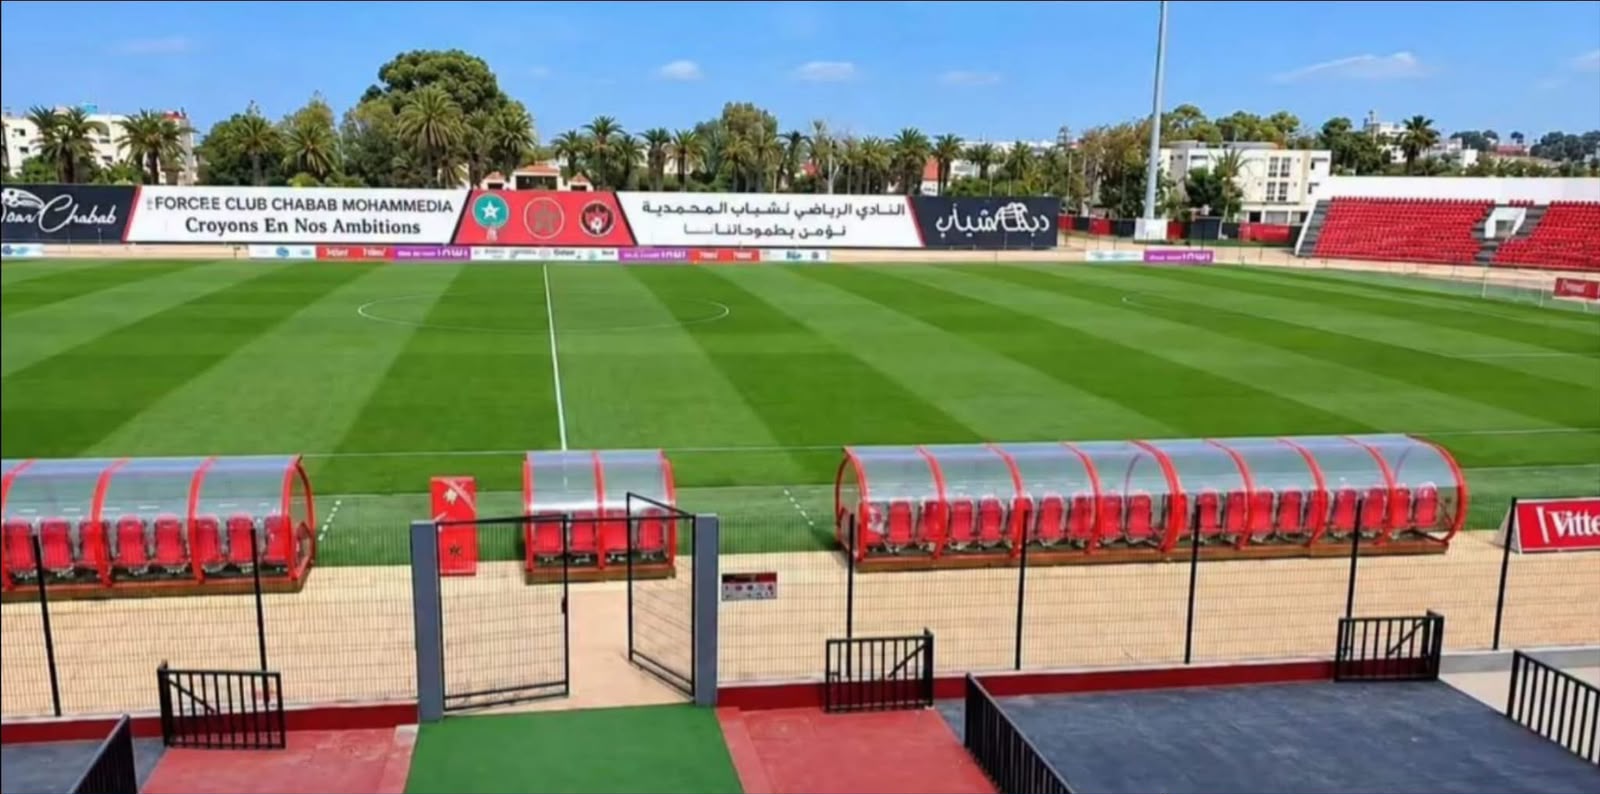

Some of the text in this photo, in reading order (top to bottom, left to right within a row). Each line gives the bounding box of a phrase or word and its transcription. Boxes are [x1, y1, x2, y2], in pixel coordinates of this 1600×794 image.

[38, 194, 117, 233] Chabab
[225, 197, 267, 211] CLUB
[271, 198, 338, 211] CHABAB
[342, 199, 454, 213] MOHAMMEDIA
[642, 200, 728, 216] المحمدية
[793, 203, 852, 220] الرياضي
[855, 203, 905, 220] النادي
[185, 217, 421, 237] Croyons En Nos Ambitions
